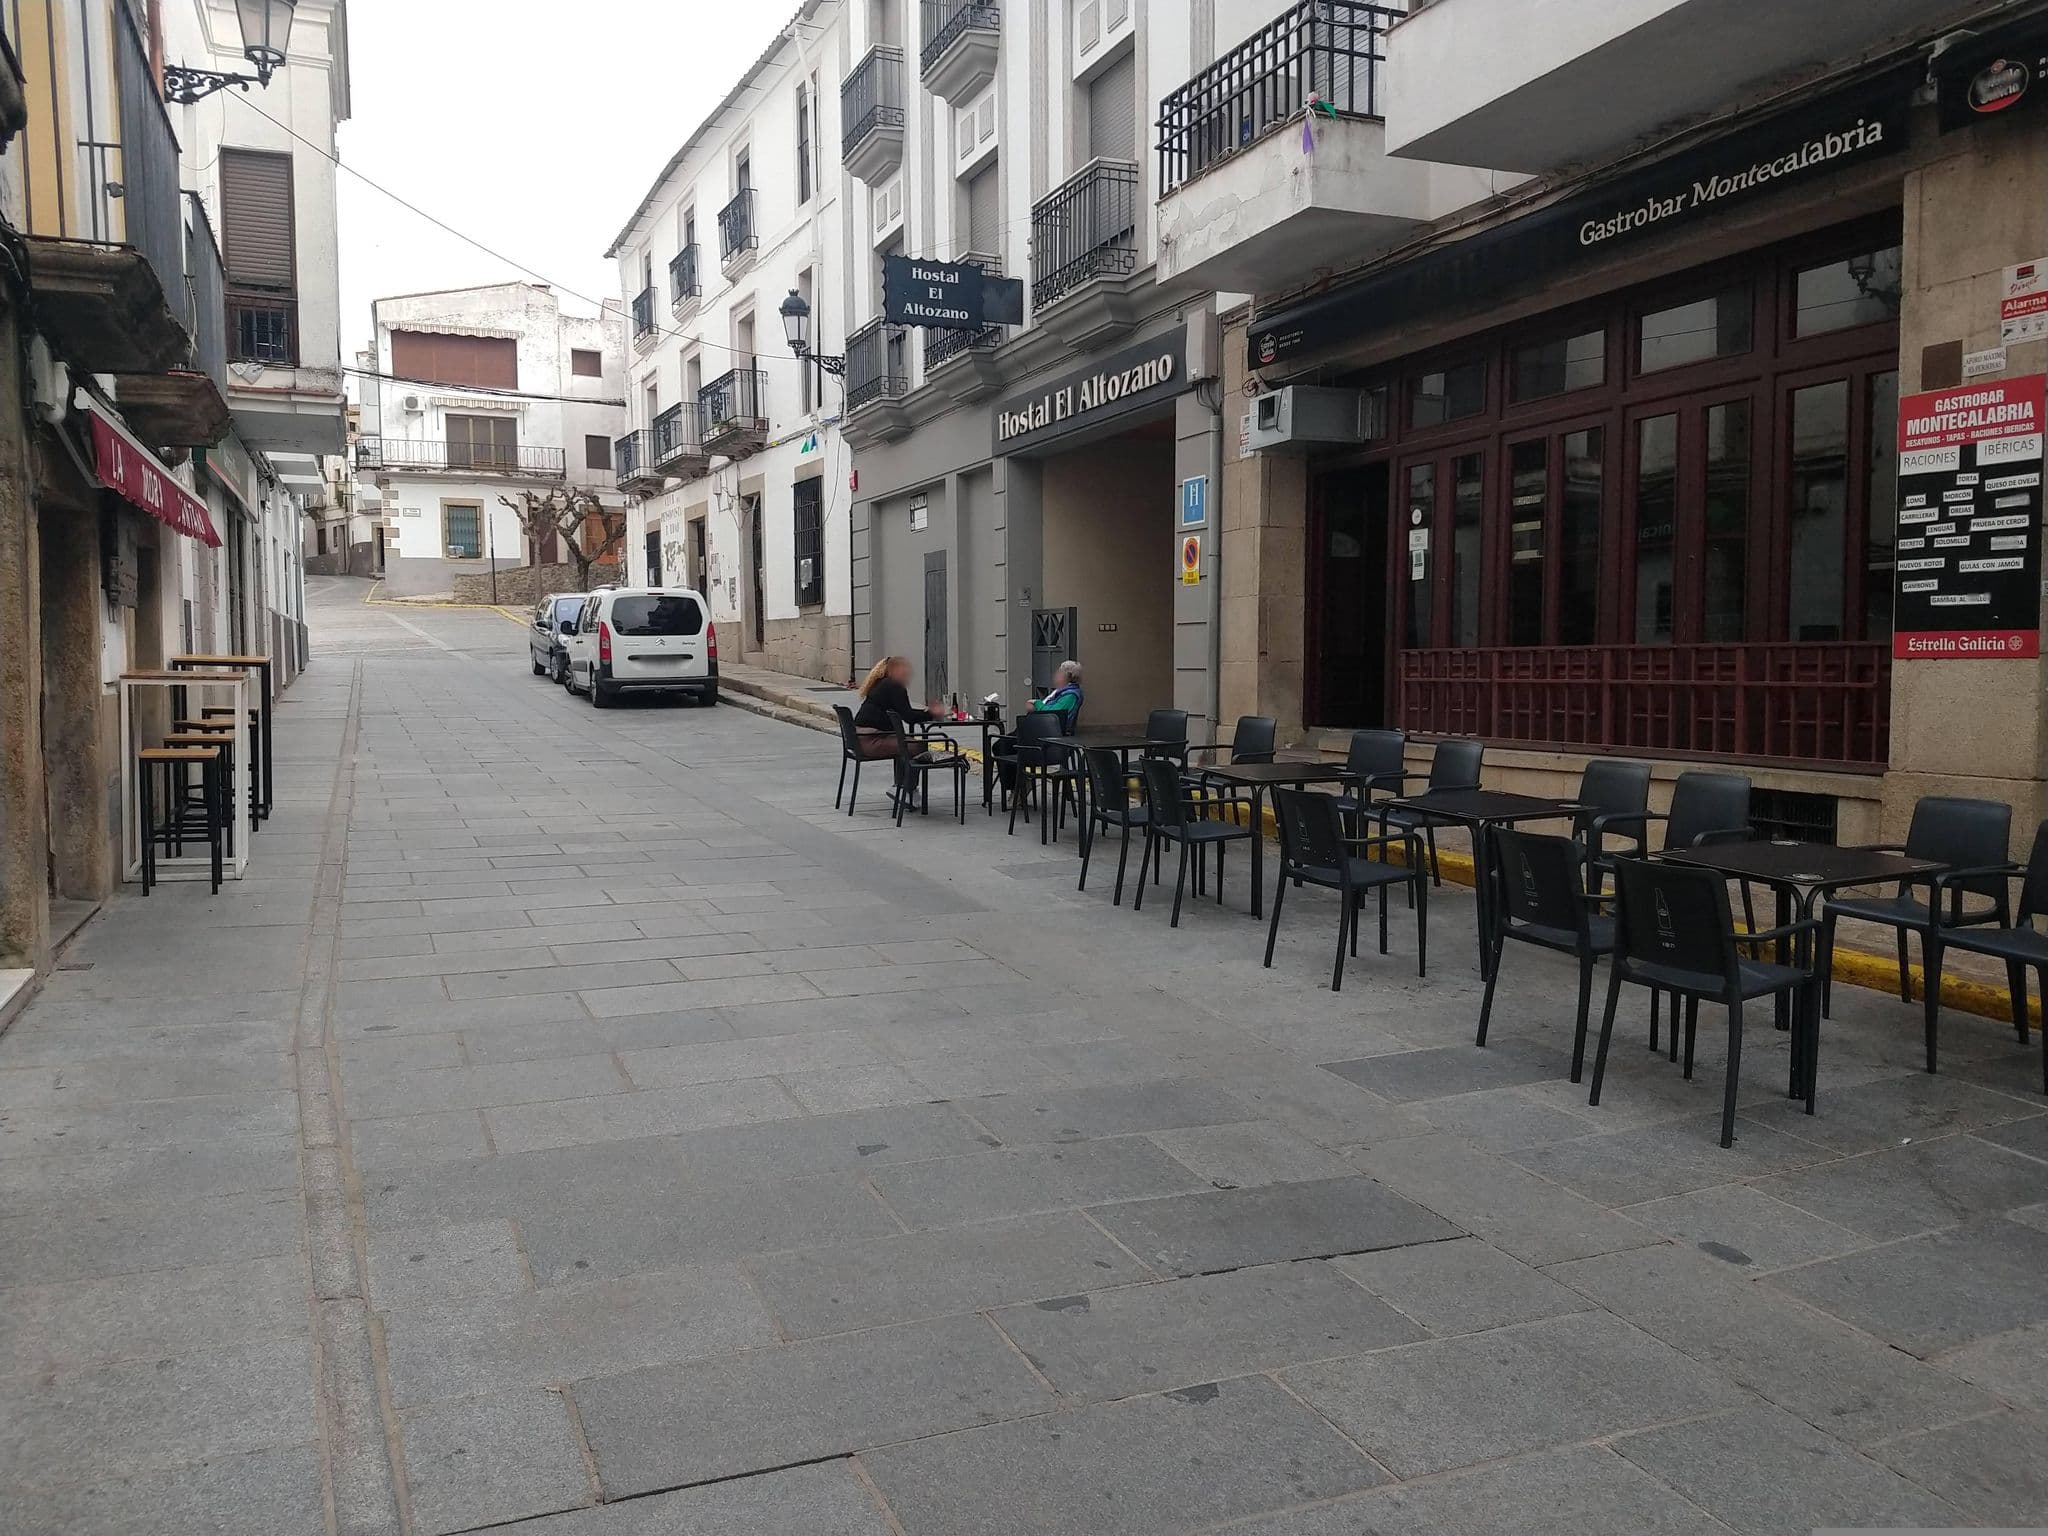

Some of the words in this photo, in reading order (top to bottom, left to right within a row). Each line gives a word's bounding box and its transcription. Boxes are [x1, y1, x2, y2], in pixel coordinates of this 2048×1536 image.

[1580, 193, 1687, 245] Gastrobar
[1690, 118, 1882, 207] Montecalabria
[911, 267, 959, 284] Hostal
[928, 287, 943, 300] El
[903, 302, 969, 320] Altozano
[2004, 296, 2047, 312] Alarma
[998, 394, 1050, 441] Hostal
[1055, 386, 1073, 421] El
[1078, 353, 1173, 413] Altozano
[1935, 389, 2005, 413] GASTROBAR
[1906, 401, 2035, 436] MONTECALABRIA
[1946, 432, 1965, 441] TAPAS
[1971, 426, 2003, 438] RACIONES
[1984, 437, 2035, 456] IBÉRICAS
[111, 438, 124, 484] LA
[1904, 452, 1956, 467] RACIONES
[1958, 474, 1977, 483] TORTA
[1986, 480, 2007, 490] QUESO
[2018, 476, 2038, 485] OVEJA
[1906, 496, 1925, 505] LOMO
[1901, 511, 1936, 521] CARRILLERAS
[1950, 506, 1972, 514] OREJAS
[1927, 524, 1953, 533] LENGUAS
[1972, 520, 1996, 528] PRUEBA
[2005, 517, 2027, 525] CERDO
[1899, 539, 1924, 547] SECRETO
[1935, 537, 1968, 545] SOLOMILLO
[1923, 560, 1943, 568] ROTOS
[1960, 562, 1980, 570] GULAS
[1903, 582, 1935, 590] GAMBONES
[1908, 637, 1956, 651] Estrella
[1958, 635, 2005, 651] Galicia
